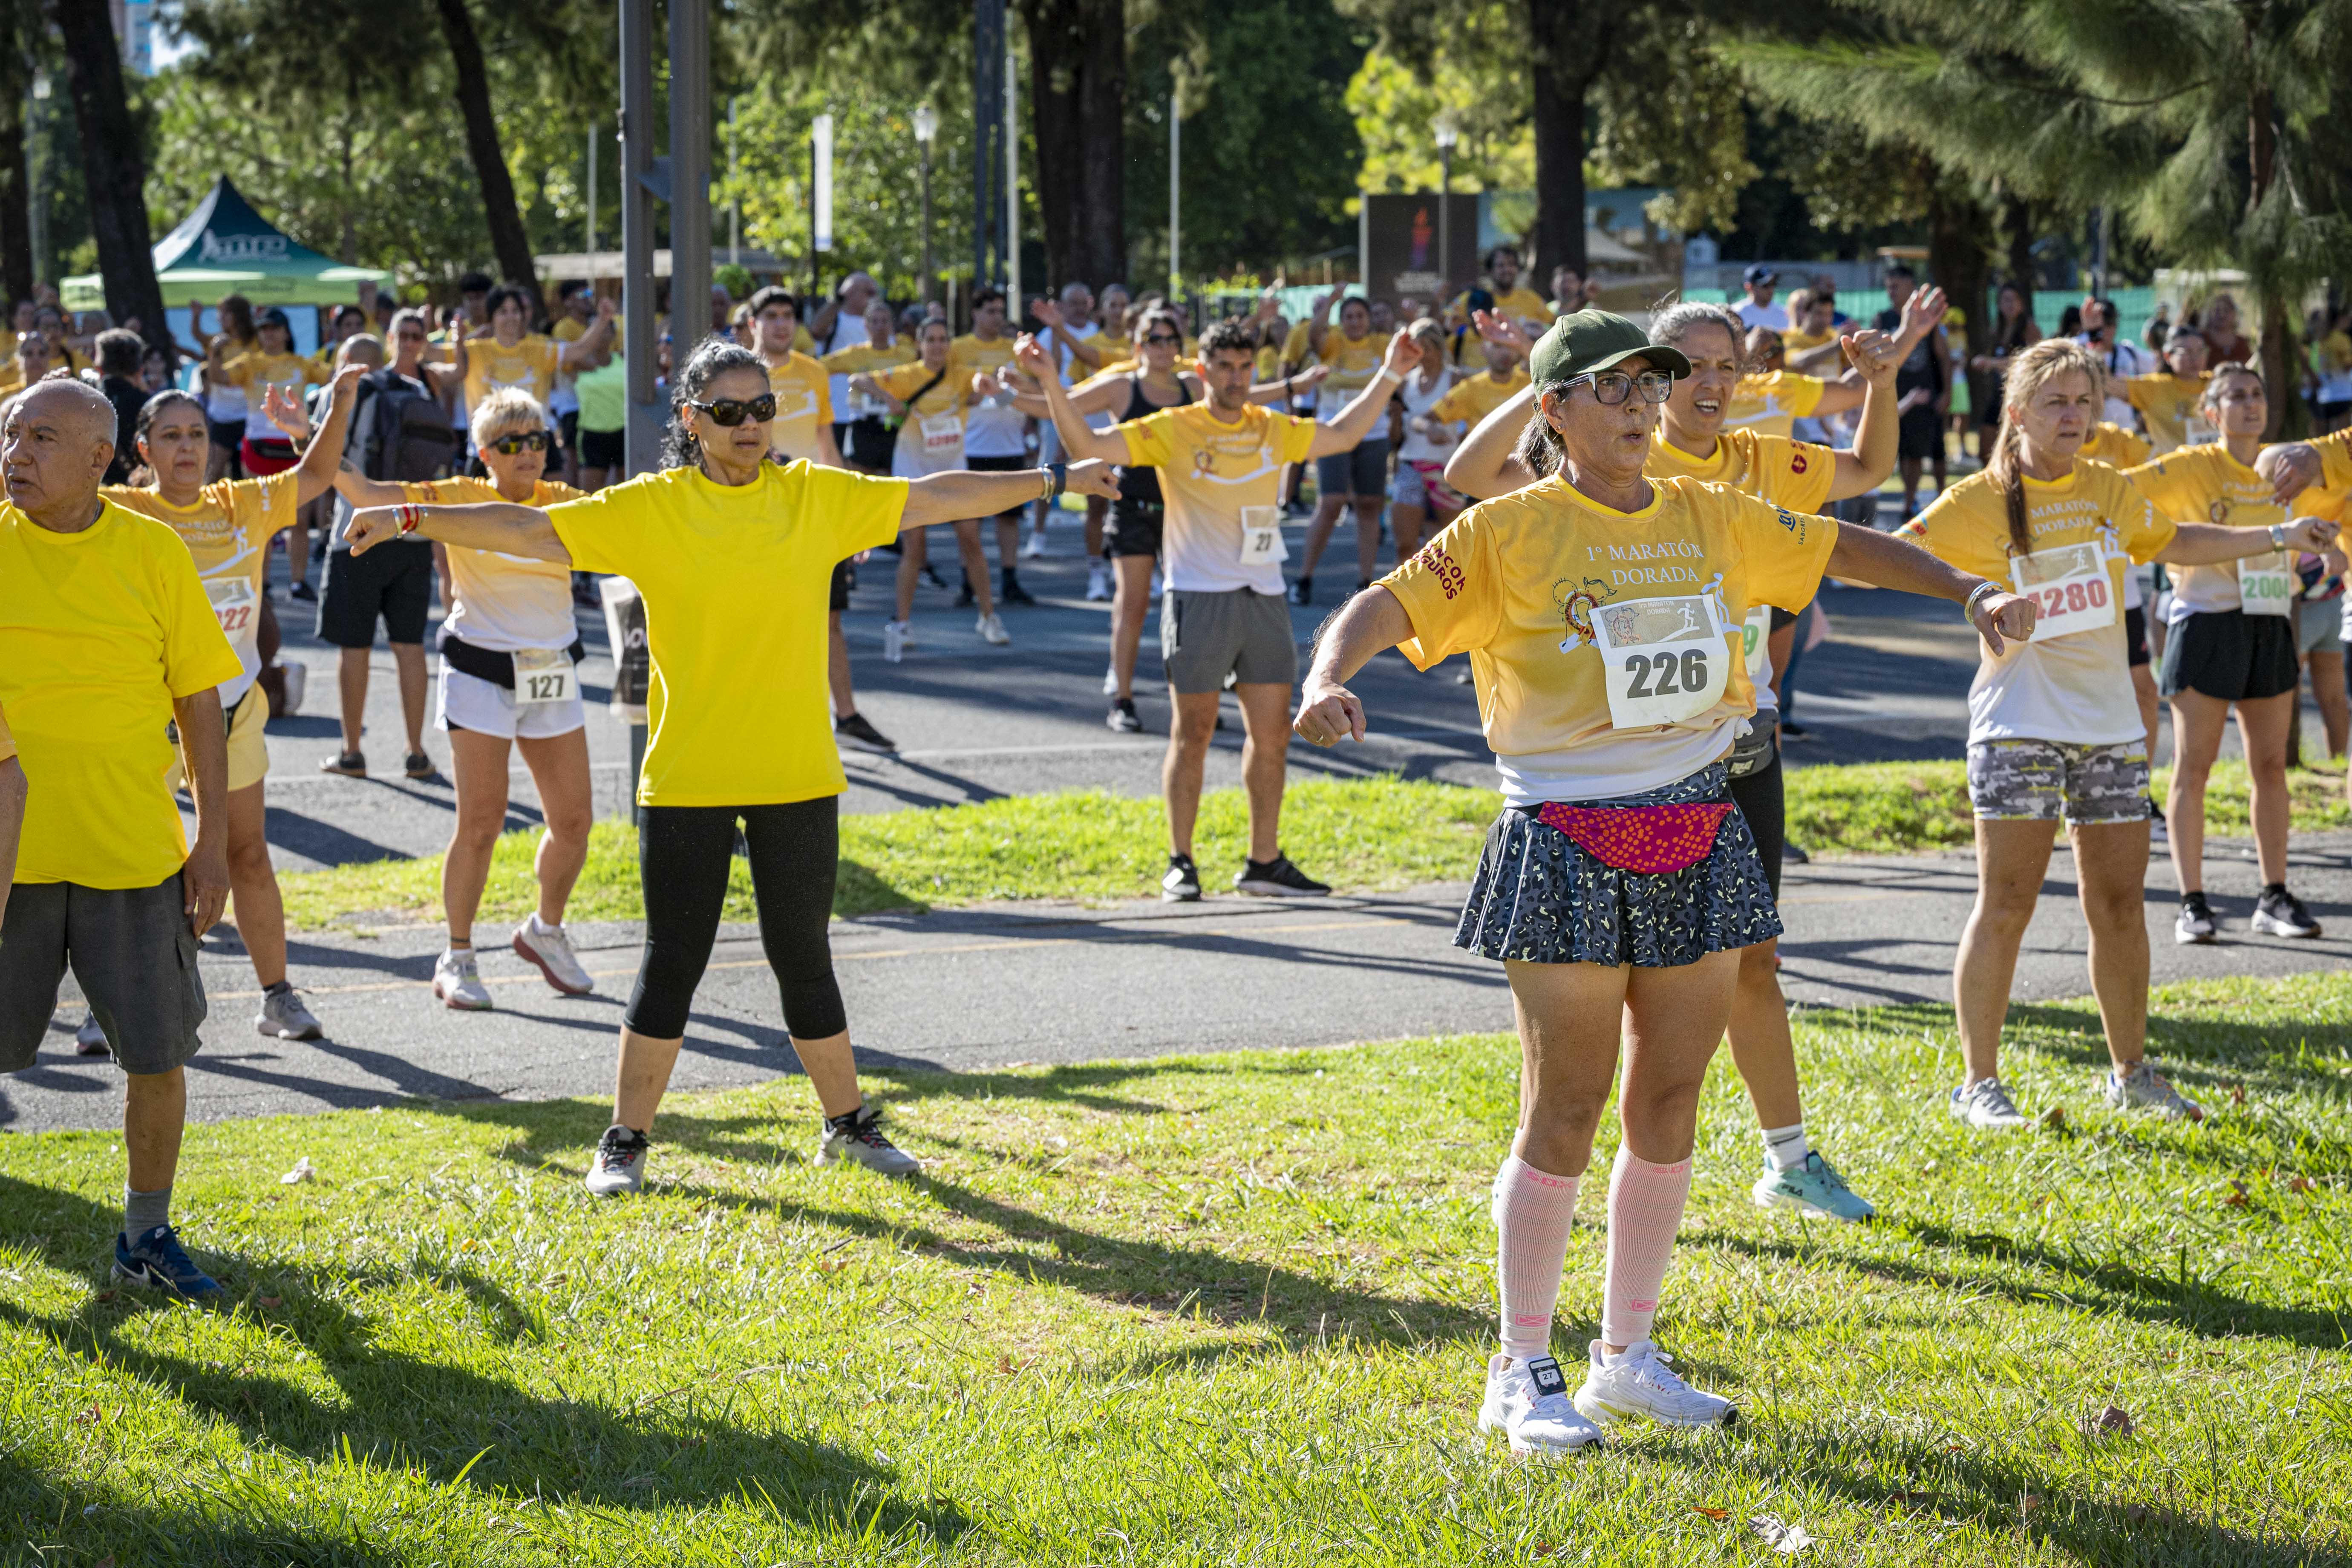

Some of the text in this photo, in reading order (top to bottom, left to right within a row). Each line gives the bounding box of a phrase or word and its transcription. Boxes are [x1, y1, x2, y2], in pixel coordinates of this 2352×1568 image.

[1607, 539, 1704, 561] MARATÓN
[1611, 566, 1701, 585] DORADA
[2027, 579, 2107, 620] 4280
[1625, 649, 1707, 699] 226
[527, 674, 564, 699] 127
[1781, 1183, 1803, 1197] FILA
[1542, 1372, 1553, 1380] 27
